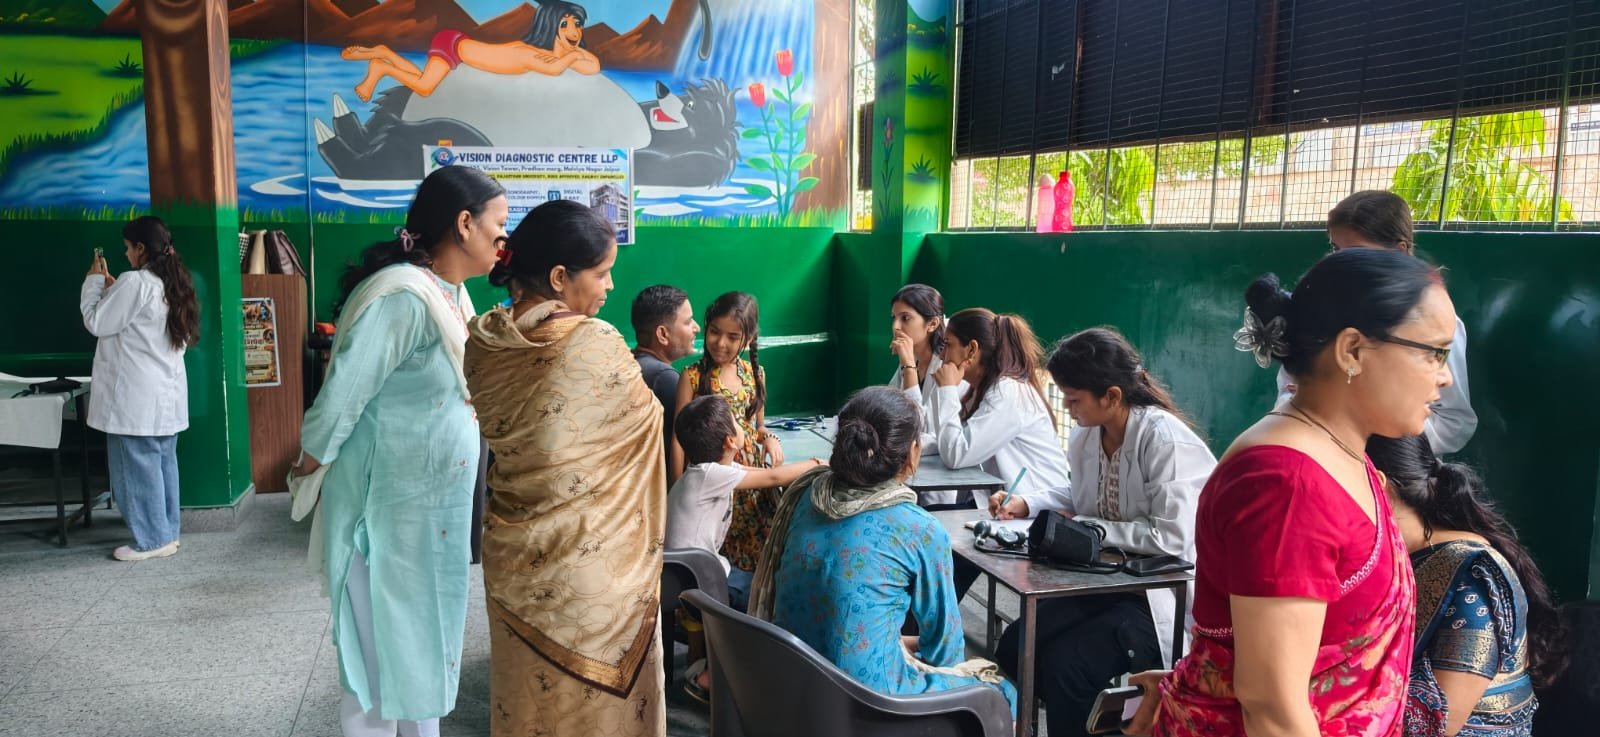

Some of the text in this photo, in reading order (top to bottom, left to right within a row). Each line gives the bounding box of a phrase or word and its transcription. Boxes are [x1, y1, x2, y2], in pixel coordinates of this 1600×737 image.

[459, 152, 618, 164] VISION DIAGNOSTIC CENTRE LLP
